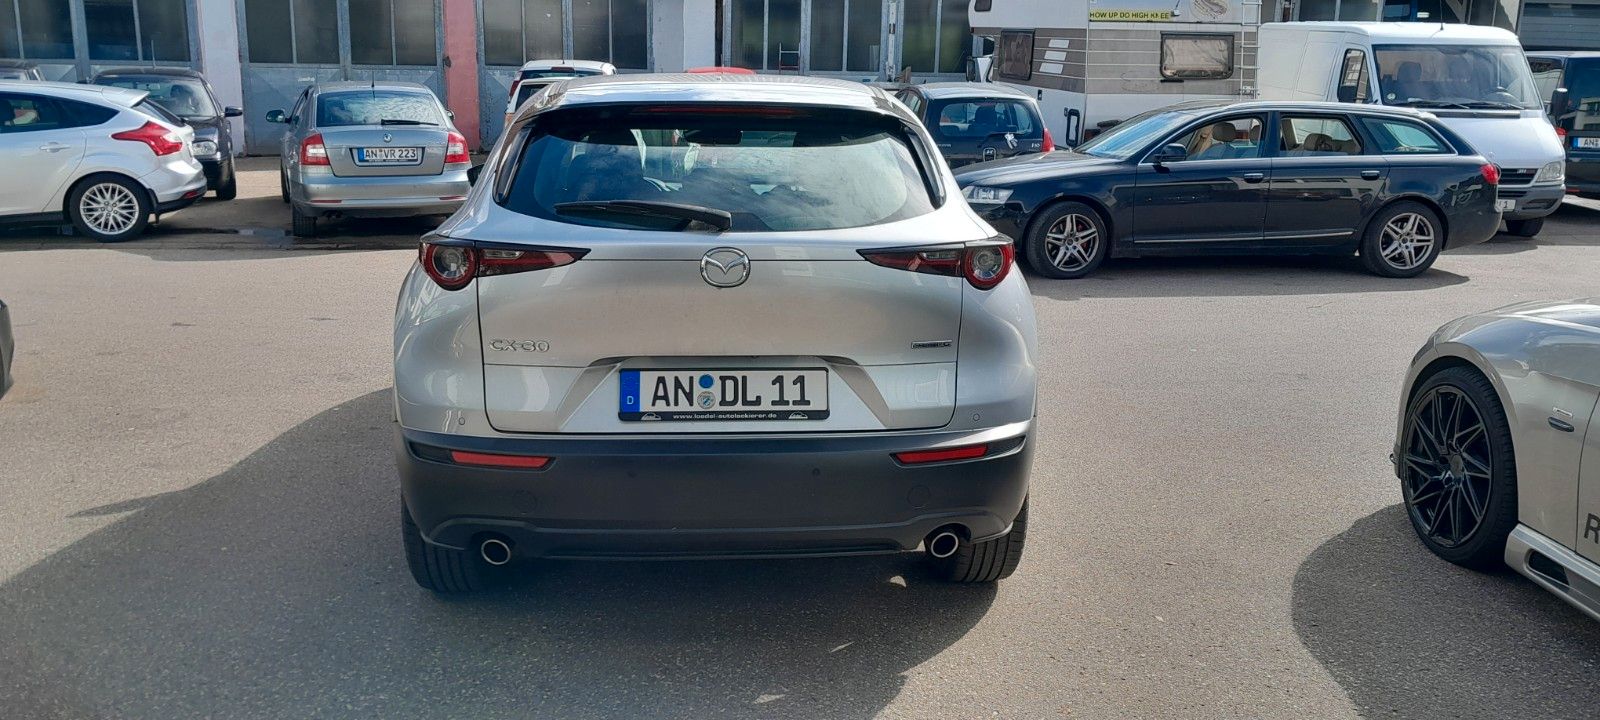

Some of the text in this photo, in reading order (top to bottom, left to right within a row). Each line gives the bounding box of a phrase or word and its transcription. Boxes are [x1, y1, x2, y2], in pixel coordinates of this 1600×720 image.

[1583, 138, 1595, 147] AN
[365, 149, 416, 158] AN VR 223
[489, 338, 550, 353] CX-30
[651, 375, 811, 407] AN DL 11
[626, 395, 634, 405] D
